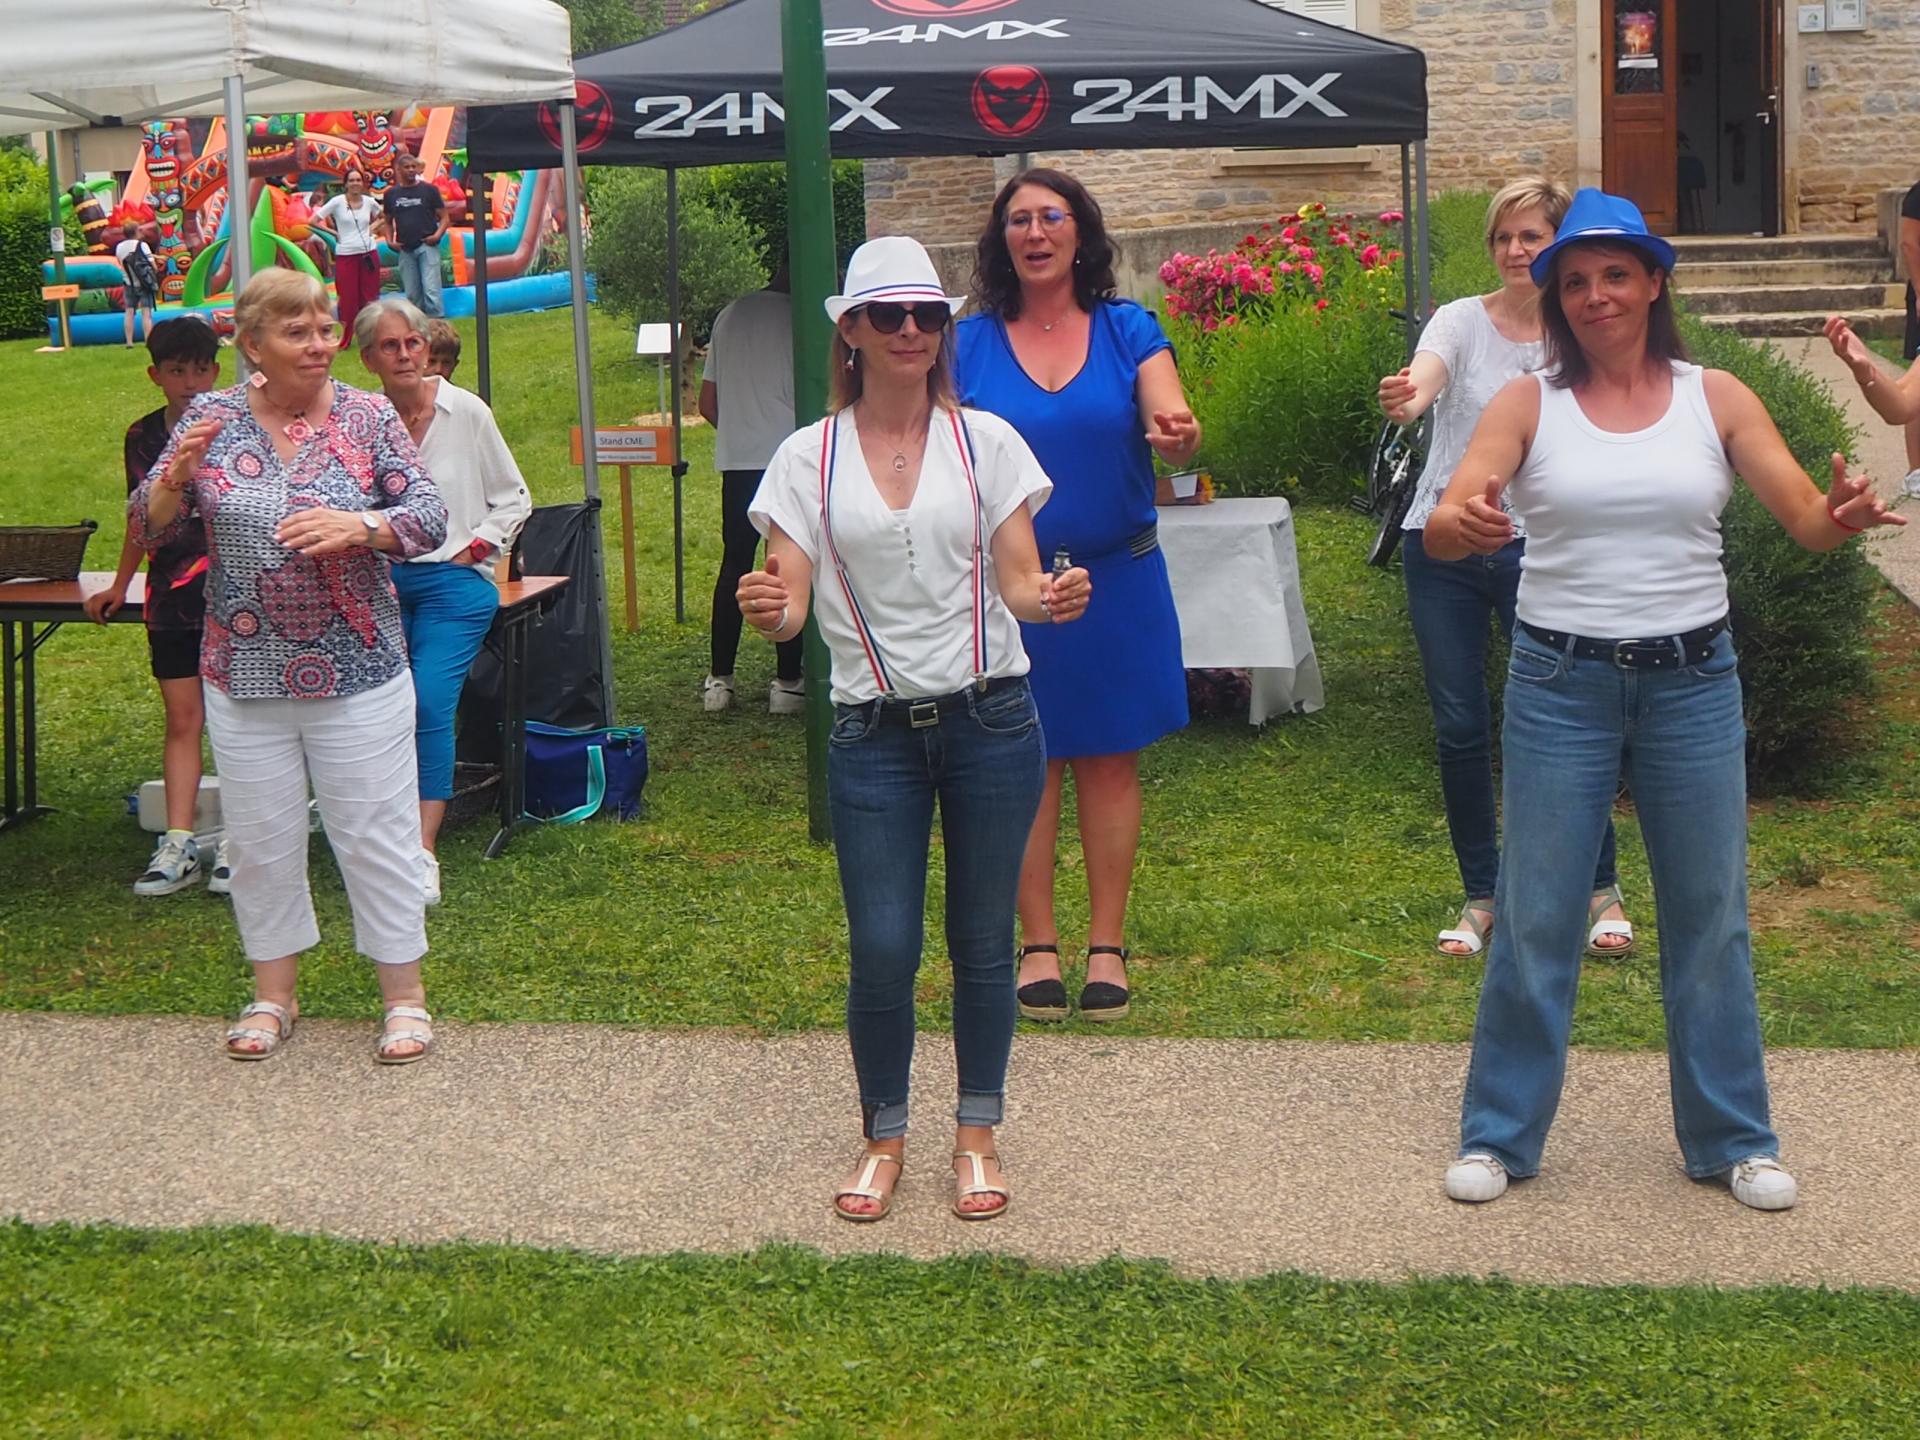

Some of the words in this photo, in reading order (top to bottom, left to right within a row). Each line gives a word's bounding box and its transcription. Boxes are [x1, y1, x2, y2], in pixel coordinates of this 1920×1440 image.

[823, 18, 1071, 46] 24MX
[1071, 72, 1349, 124] 24MX
[599, 437, 622, 446] Stand
[624, 437, 643, 446] CME
